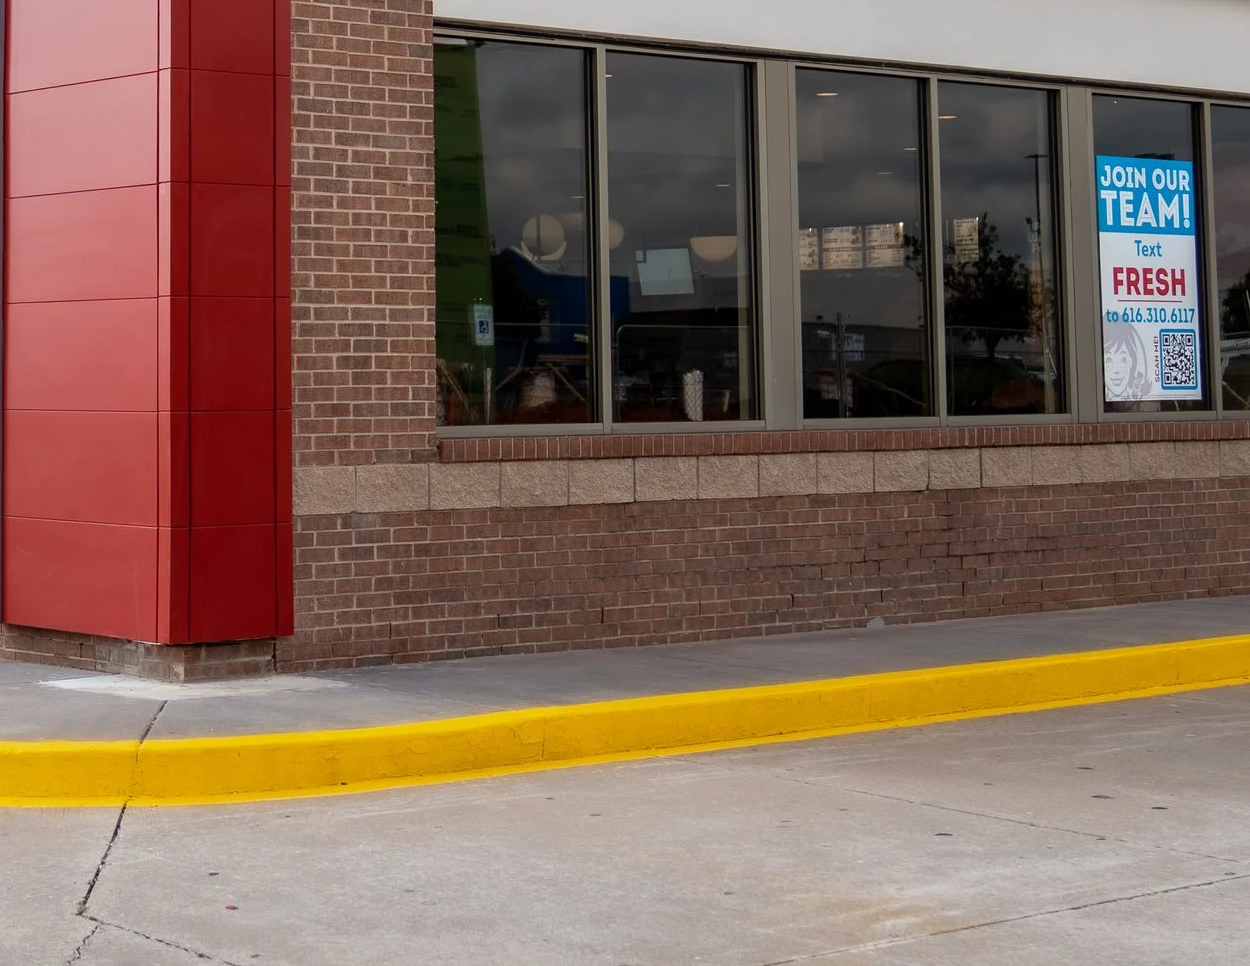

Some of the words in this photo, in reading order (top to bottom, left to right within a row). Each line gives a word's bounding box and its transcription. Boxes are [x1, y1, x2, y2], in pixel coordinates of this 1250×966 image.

[1100, 165, 1147, 189] JOIN
[1152, 168, 1190, 192] OUR
[1100, 190, 1191, 229] TEAM!
[1134, 239, 1162, 257] Text
[1112, 266, 1186, 297] FRESH
[1106, 308, 1119, 323] to
[1121, 307, 1195, 324] 616.310.6117
